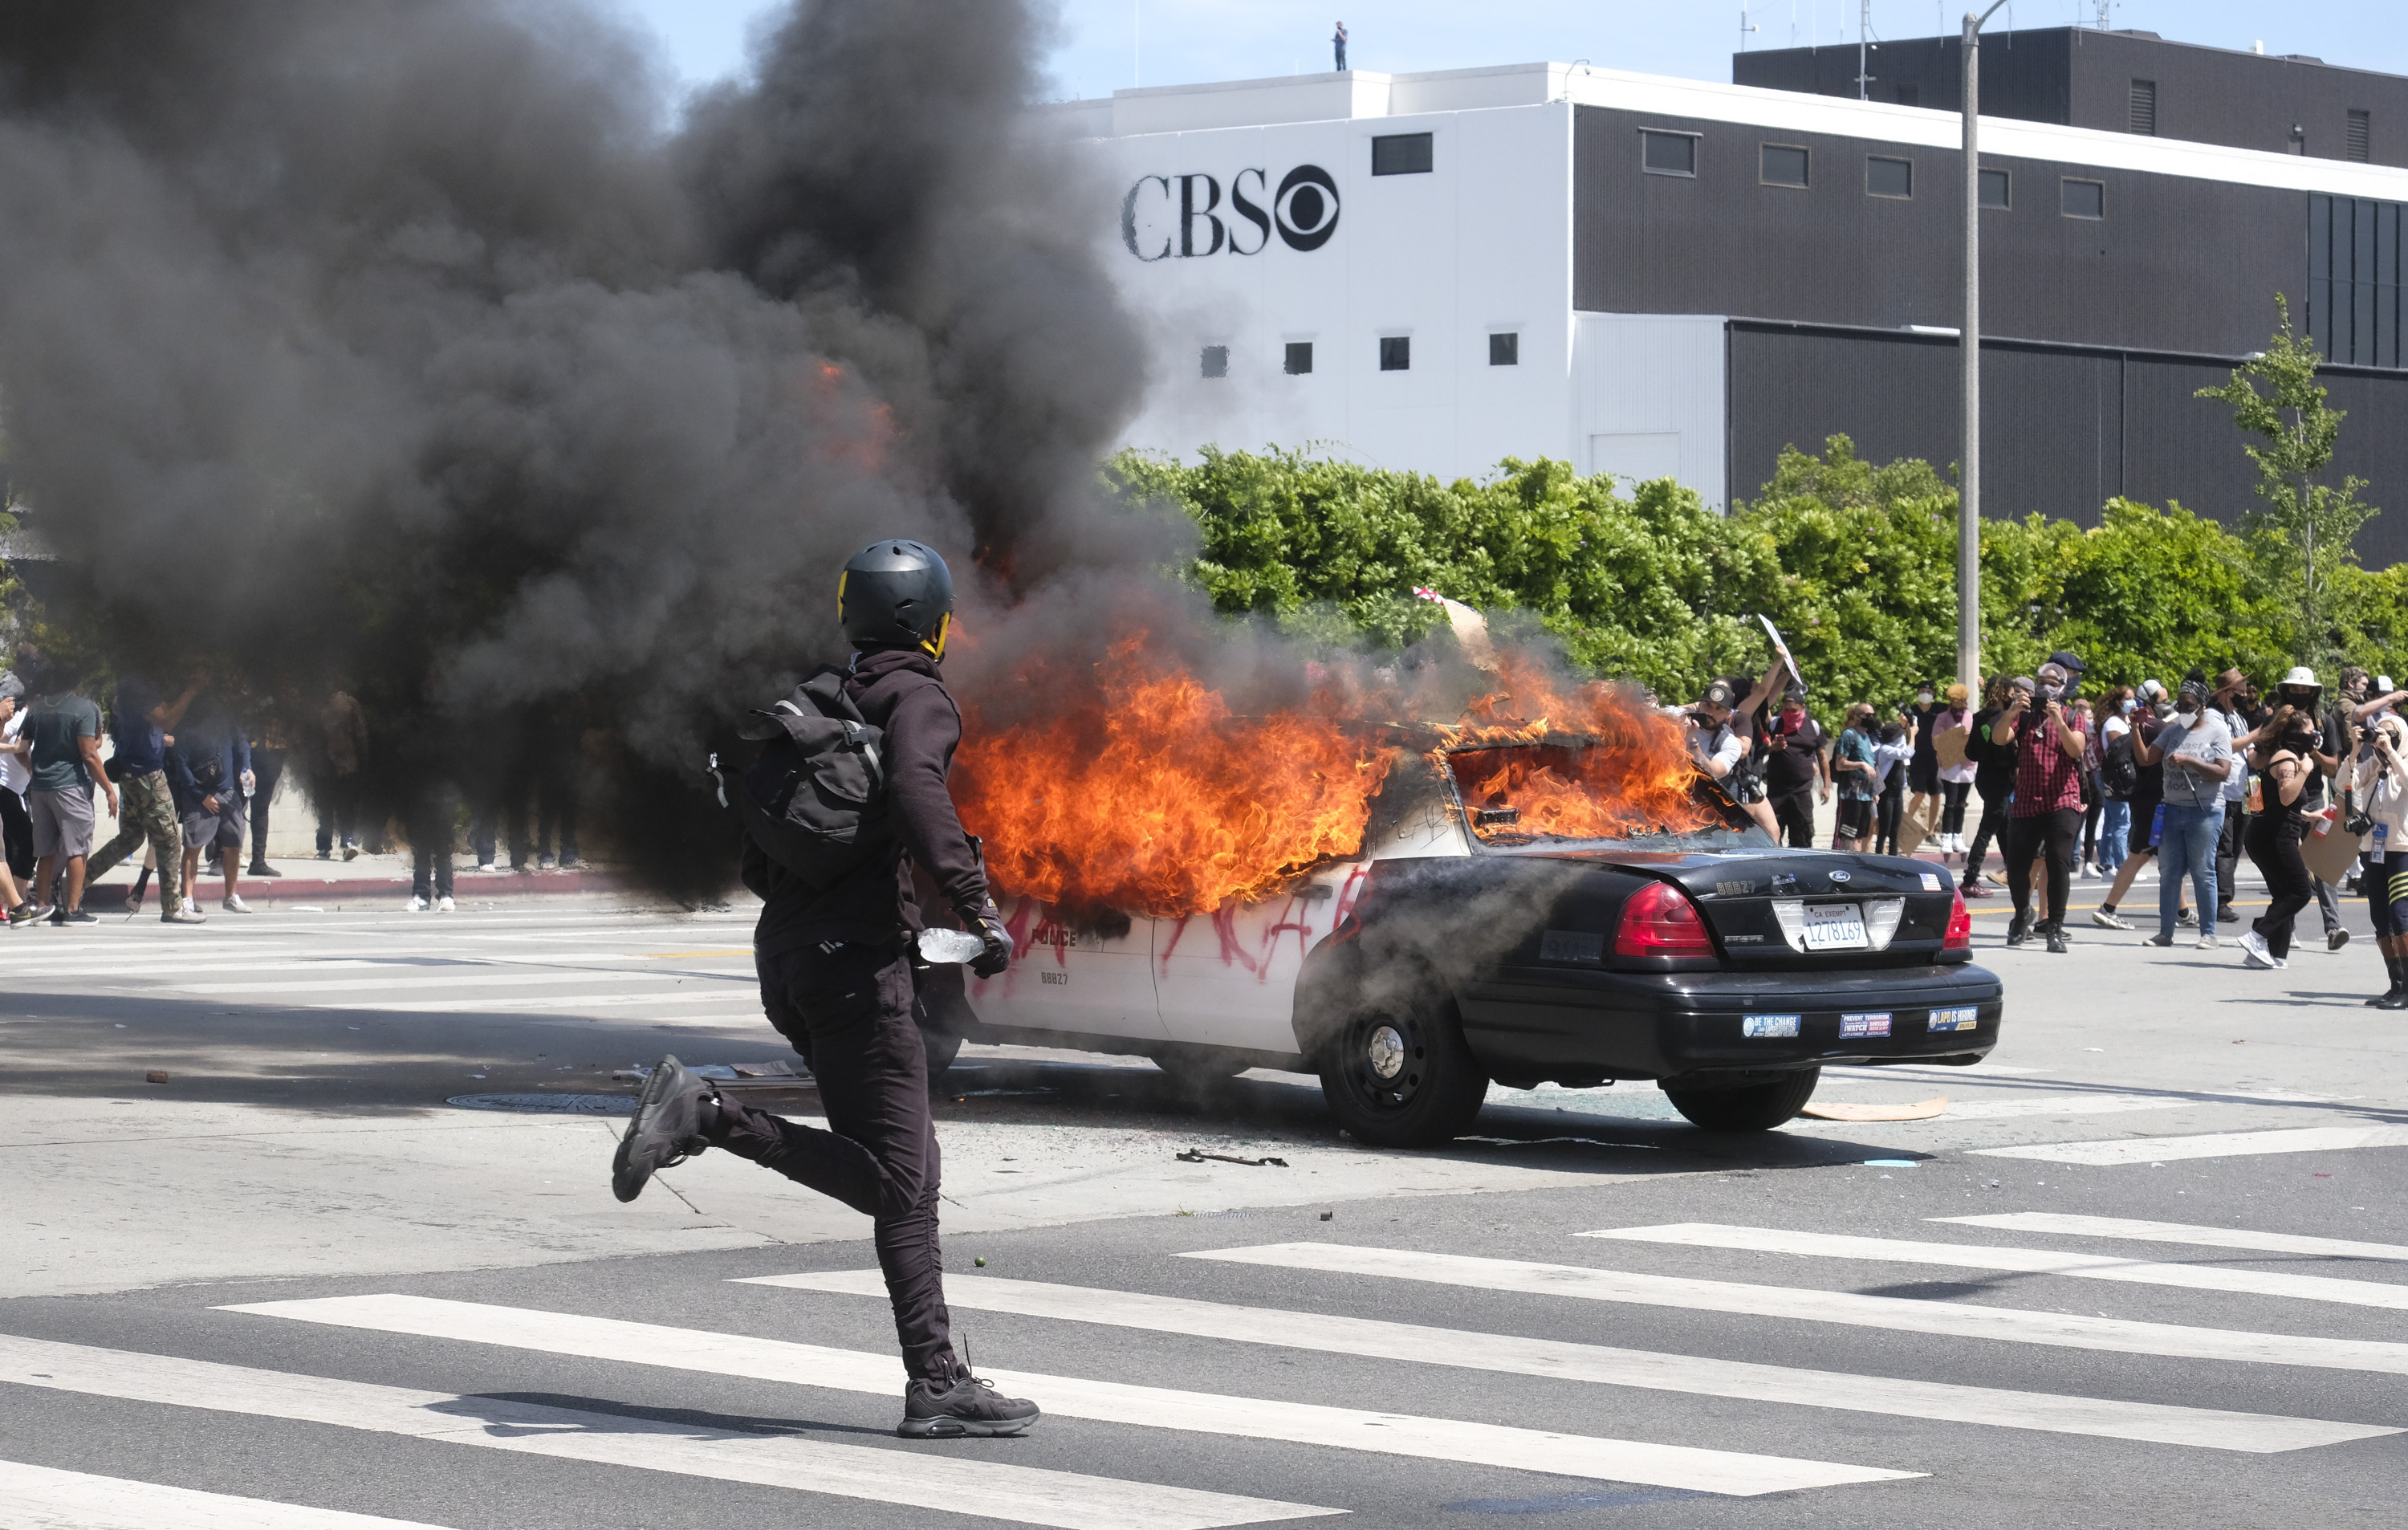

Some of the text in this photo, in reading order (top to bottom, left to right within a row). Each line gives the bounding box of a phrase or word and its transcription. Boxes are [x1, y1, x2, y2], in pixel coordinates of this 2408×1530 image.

[1121, 169, 1271, 262] CBS
[1031, 929, 1076, 946] POLICE
[1807, 920, 1861, 942] 1278169
[1041, 972, 1068, 985] 88827
[1755, 1017, 1796, 1026] BE THE CHANGE
[1938, 1009, 1976, 1023] LAPD IS HIRING!
